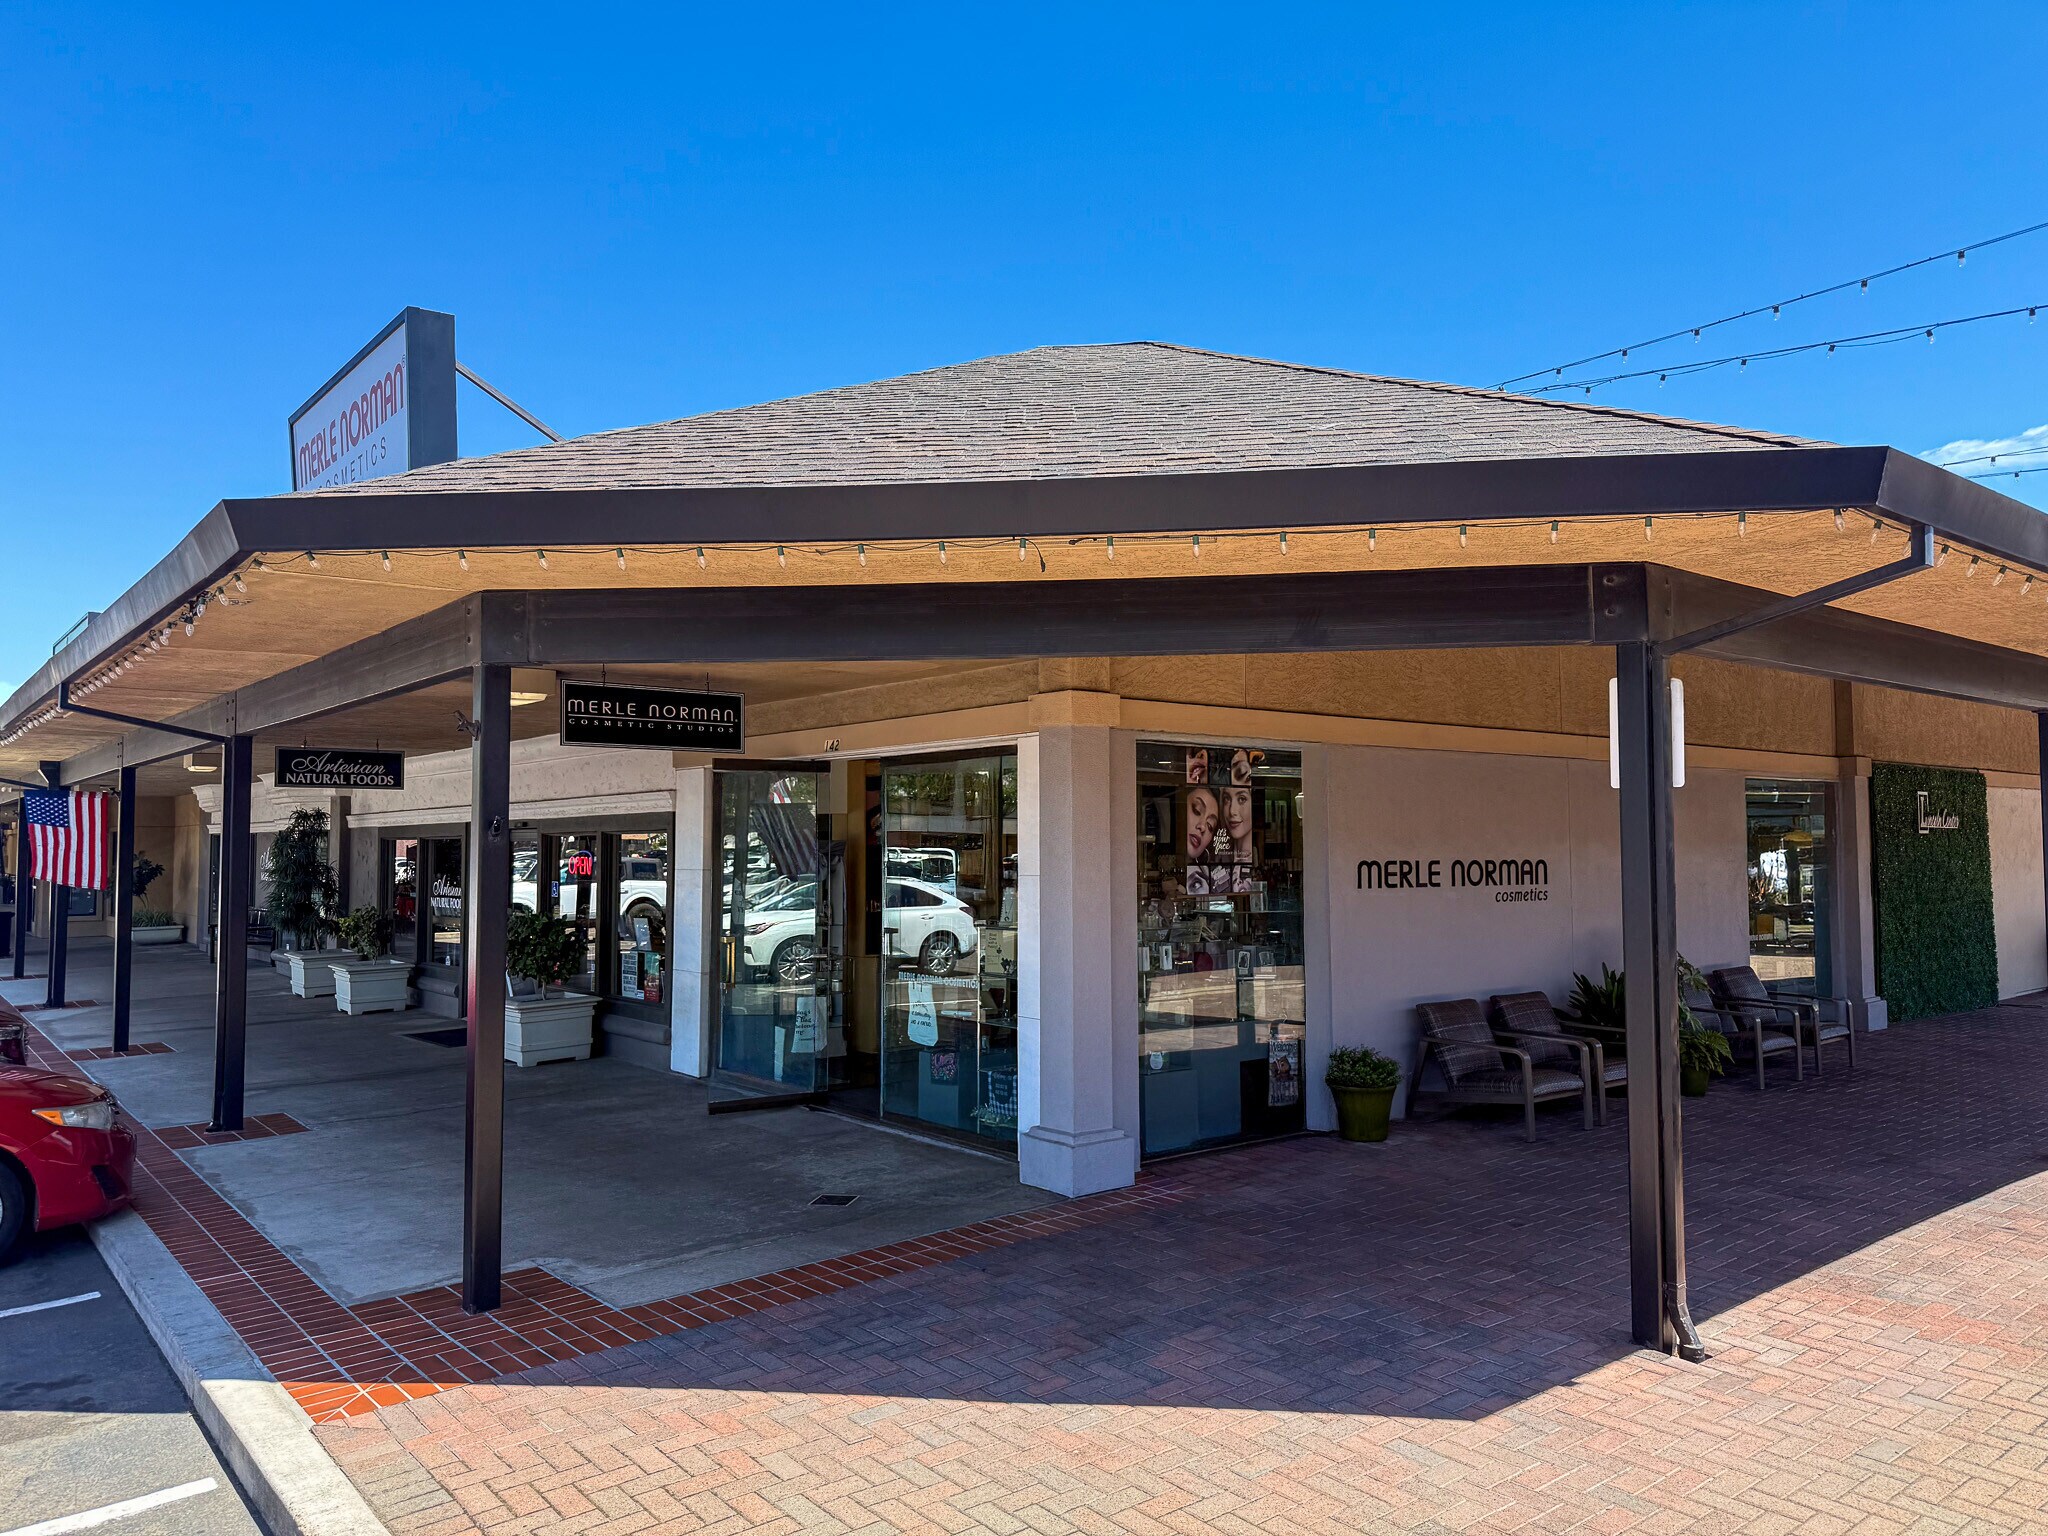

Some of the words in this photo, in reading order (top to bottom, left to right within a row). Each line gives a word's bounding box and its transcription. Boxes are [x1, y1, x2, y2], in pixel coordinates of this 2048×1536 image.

[299, 419, 337, 488] MERLE
[567, 699, 637, 716] MERLE
[568, 718, 655, 730] COSMETIC
[666, 724, 734, 733] STUDIOS
[825, 739, 840, 752] 142
[291, 751, 387, 774] Artesian
[285, 772, 347, 785] NATURAL
[350, 774, 395, 786] FOODS
[1214, 842, 1231, 855] face
[568, 856, 593, 876] OPEN
[1357, 860, 1441, 889] MERLE
[1451, 858, 1548, 887] NORMAN
[1495, 887, 1549, 903] cosmetics
